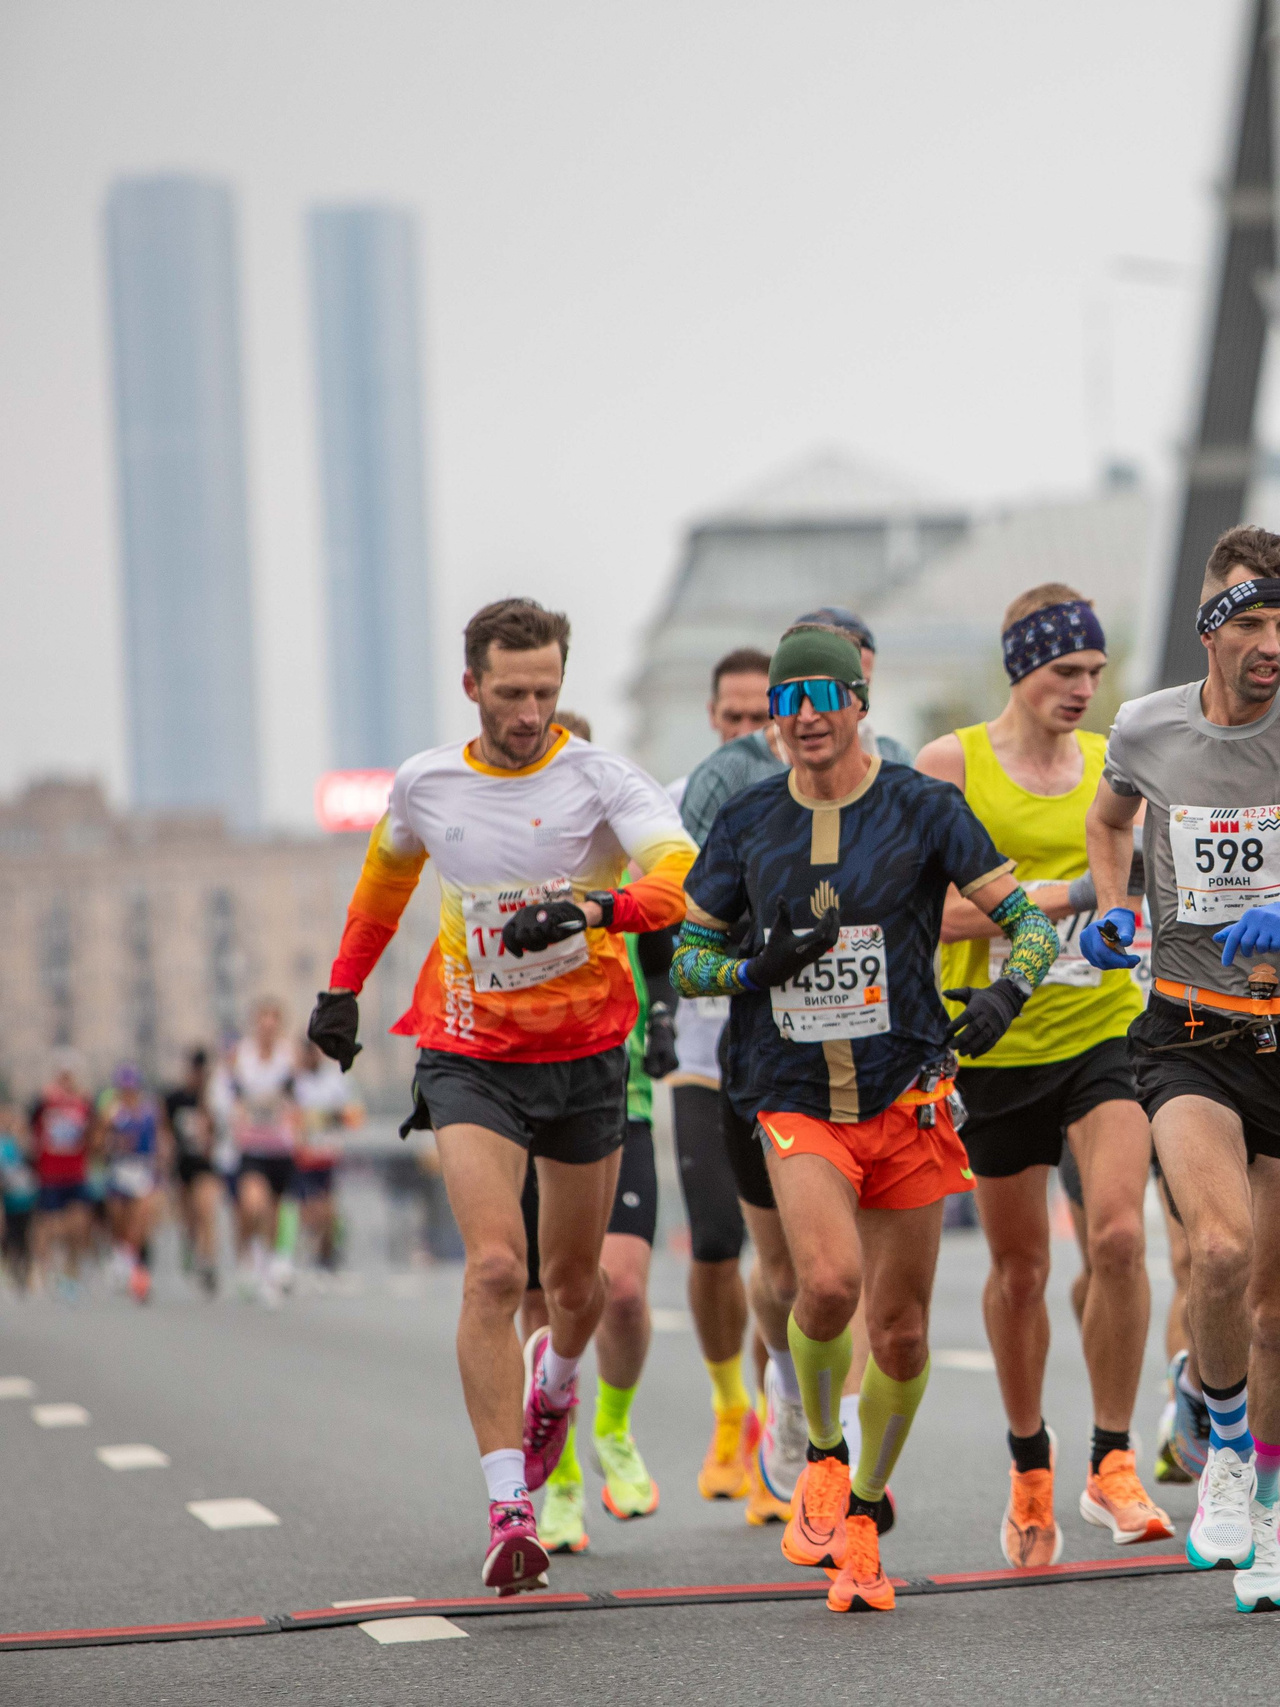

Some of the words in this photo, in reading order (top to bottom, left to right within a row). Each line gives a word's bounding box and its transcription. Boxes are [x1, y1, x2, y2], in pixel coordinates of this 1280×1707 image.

[1242, 807, 1267, 819] 42,2
[1194, 837, 1264, 874] 598
[1208, 876, 1251, 888] РОМАН
[1185, 891, 1197, 912] A
[489, 973, 503, 989] A
[780, 956, 881, 992] 4559
[804, 994, 850, 1007] ВИКТОР
[782, 1012, 795, 1031] A
